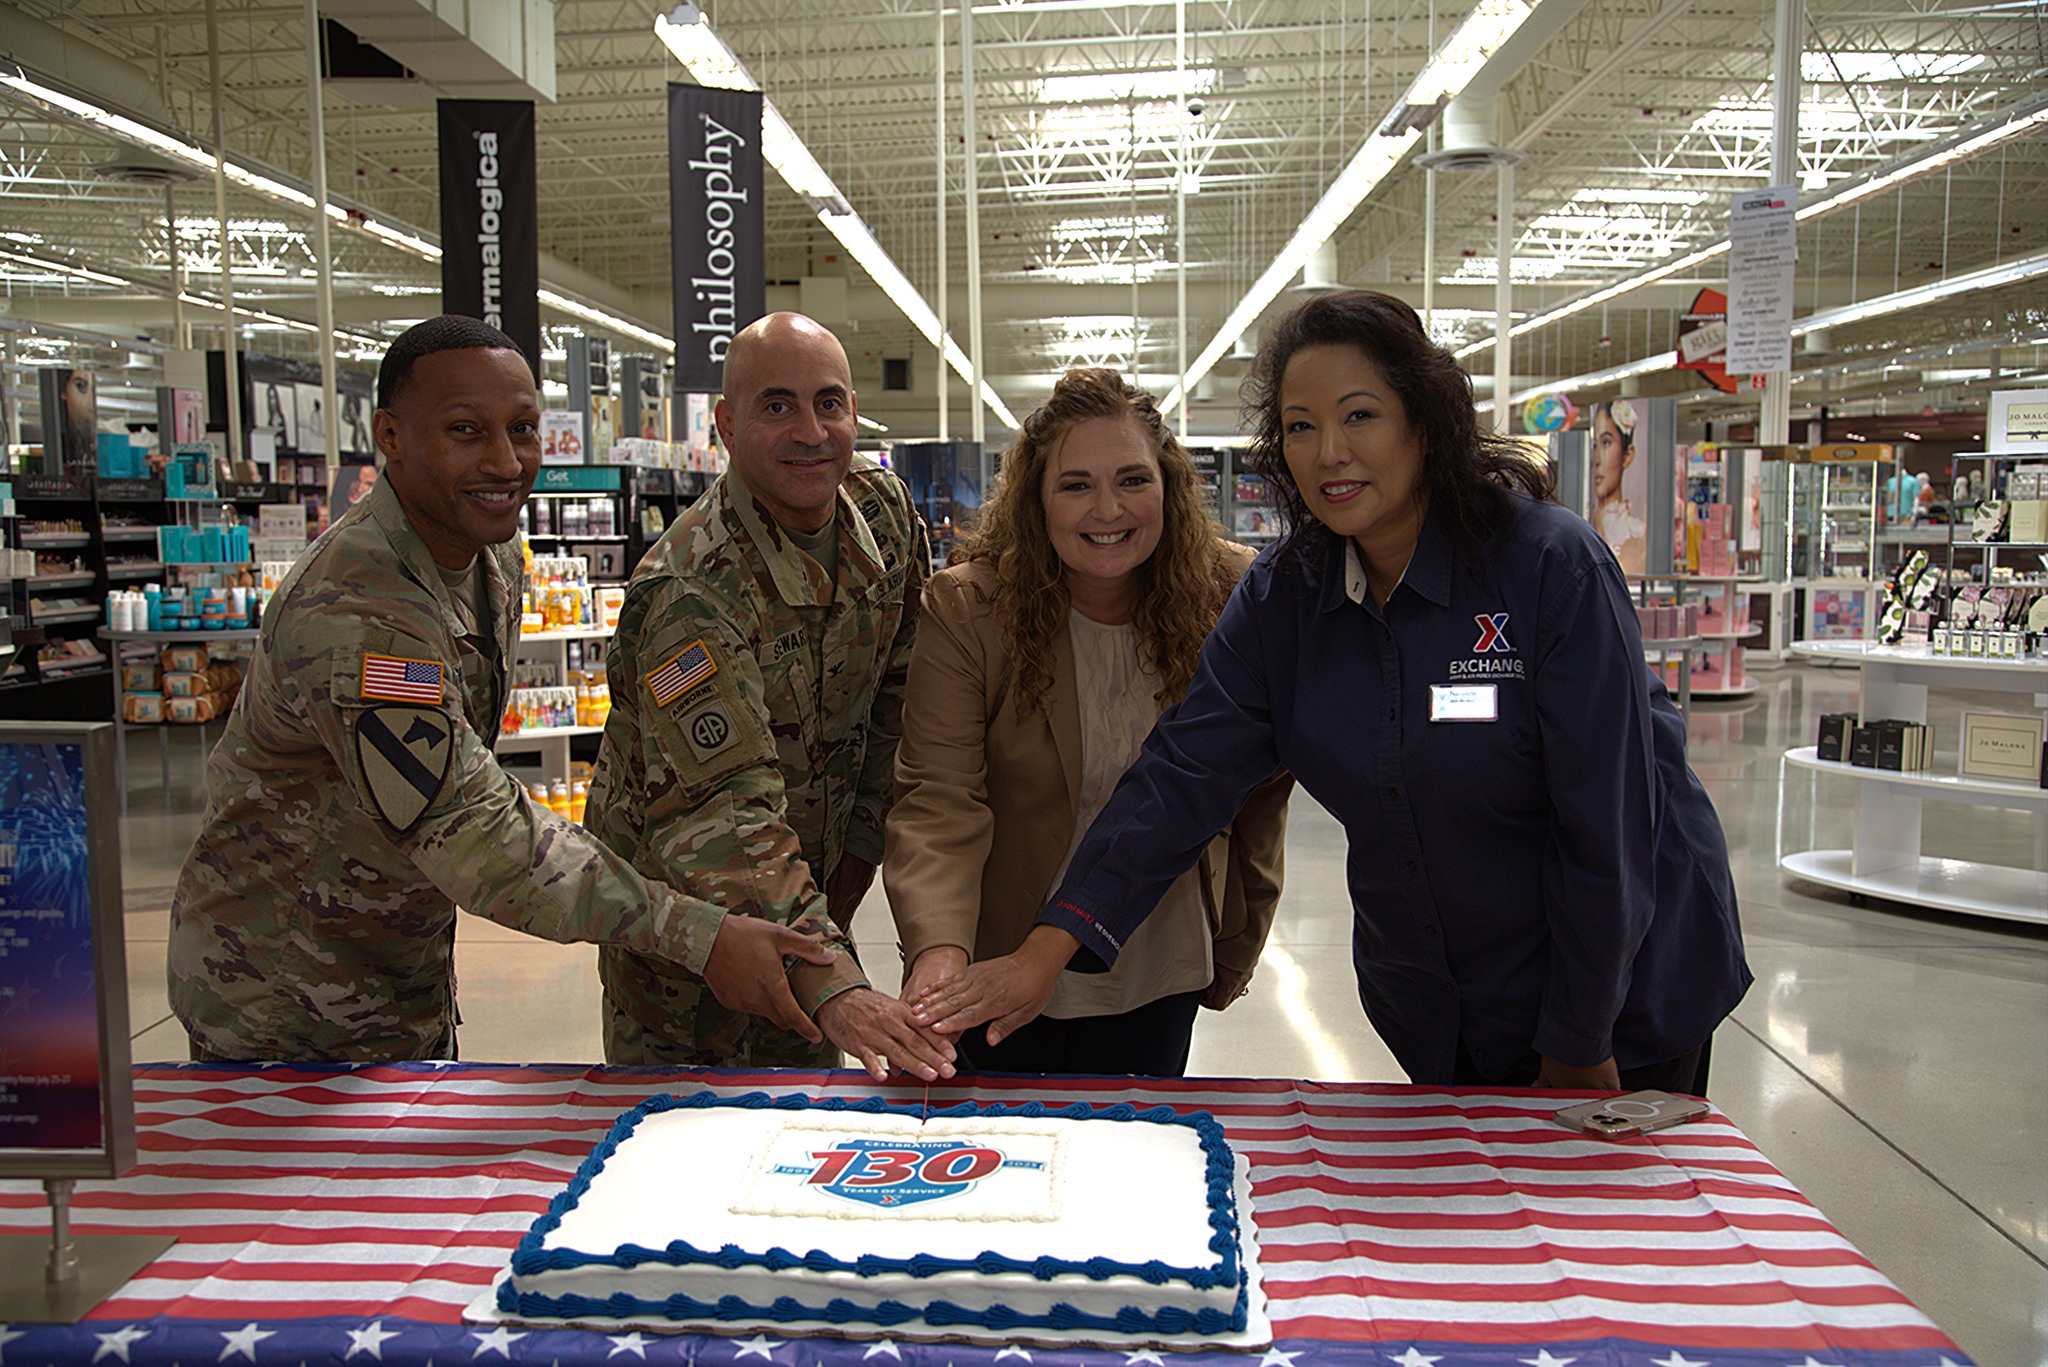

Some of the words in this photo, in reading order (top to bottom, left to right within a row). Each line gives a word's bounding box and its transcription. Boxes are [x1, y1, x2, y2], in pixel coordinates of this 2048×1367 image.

[476, 132, 504, 330] ermalogica
[688, 114, 748, 364] philosophy
[545, 469, 569, 482] Get
[774, 627, 809, 661] SEWAR
[1449, 658, 1525, 674] EXCHANG
[672, 685, 713, 717] AIRBORNE
[864, 1141, 952, 1149] CELEBRATING
[807, 1148, 1003, 1187] 130
